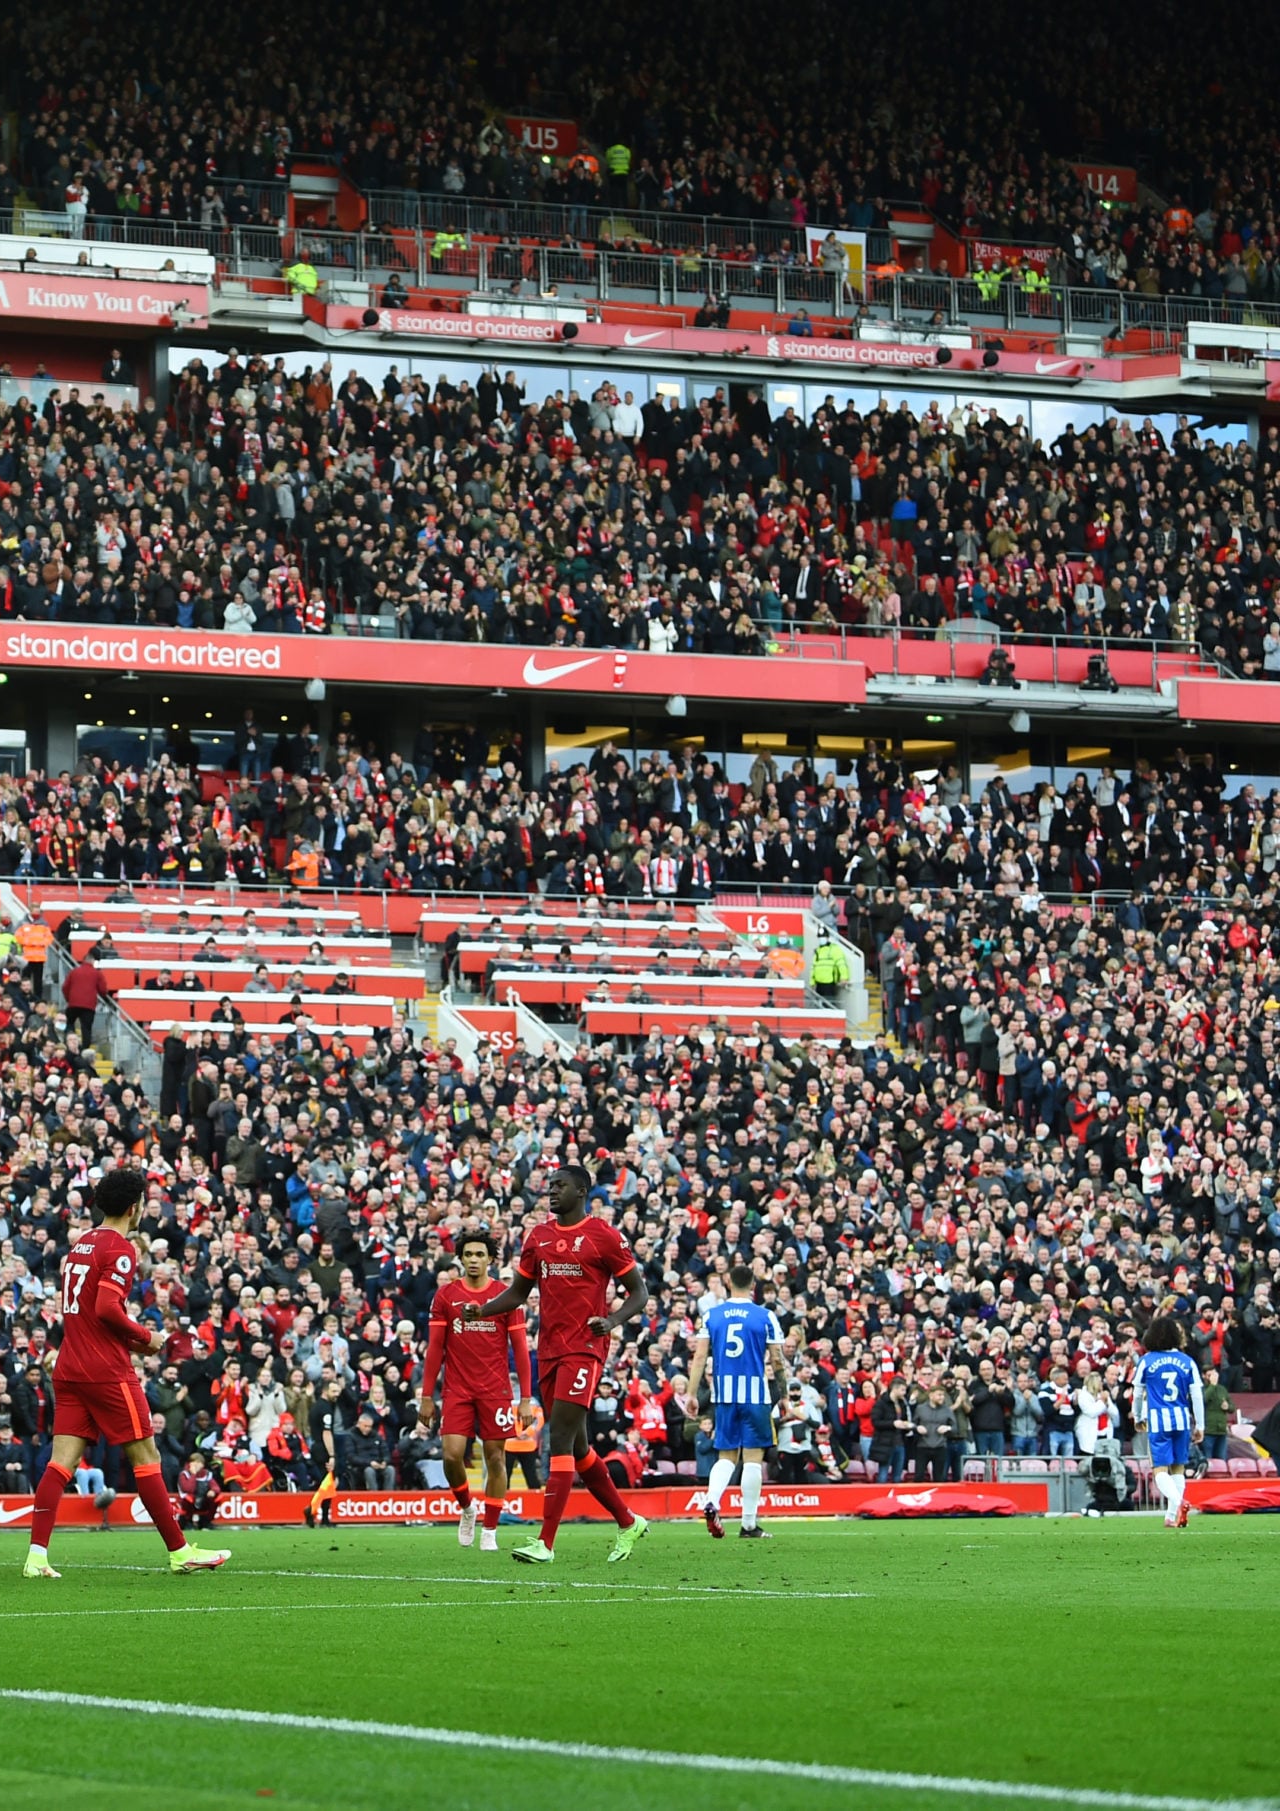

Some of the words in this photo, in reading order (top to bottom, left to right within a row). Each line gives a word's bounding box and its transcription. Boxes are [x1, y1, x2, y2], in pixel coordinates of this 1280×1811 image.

[526, 126, 558, 149] U5
[1086, 173, 1120, 196] U4
[974, 242, 1002, 258] DEUS
[28, 287, 89, 309] Know
[93, 291, 133, 312] You
[136, 294, 177, 314] Can
[397, 315, 472, 333] standard
[475, 321, 554, 339] chartered
[784, 341, 856, 359] standard
[858, 347, 936, 366] chartered
[6, 633, 137, 663] standard
[143, 640, 280, 669] chartered
[747, 915, 770, 933] L6
[70, 1243, 95, 1255] JONES
[548, 1262, 581, 1270] standard
[548, 1269, 583, 1277] chartered
[63, 1262, 90, 1314] 17
[724, 1308, 749, 1318] DUNK
[725, 1323, 745, 1358] 5
[1148, 1356, 1190, 1375] CUCURELLA
[573, 1367, 589, 1389] 5
[1161, 1371, 1179, 1402] 3
[337, 1497, 426, 1516] standard
[429, 1497, 523, 1516] chateed
[768, 1494, 793, 1507] You
[794, 1493, 820, 1506] Can
